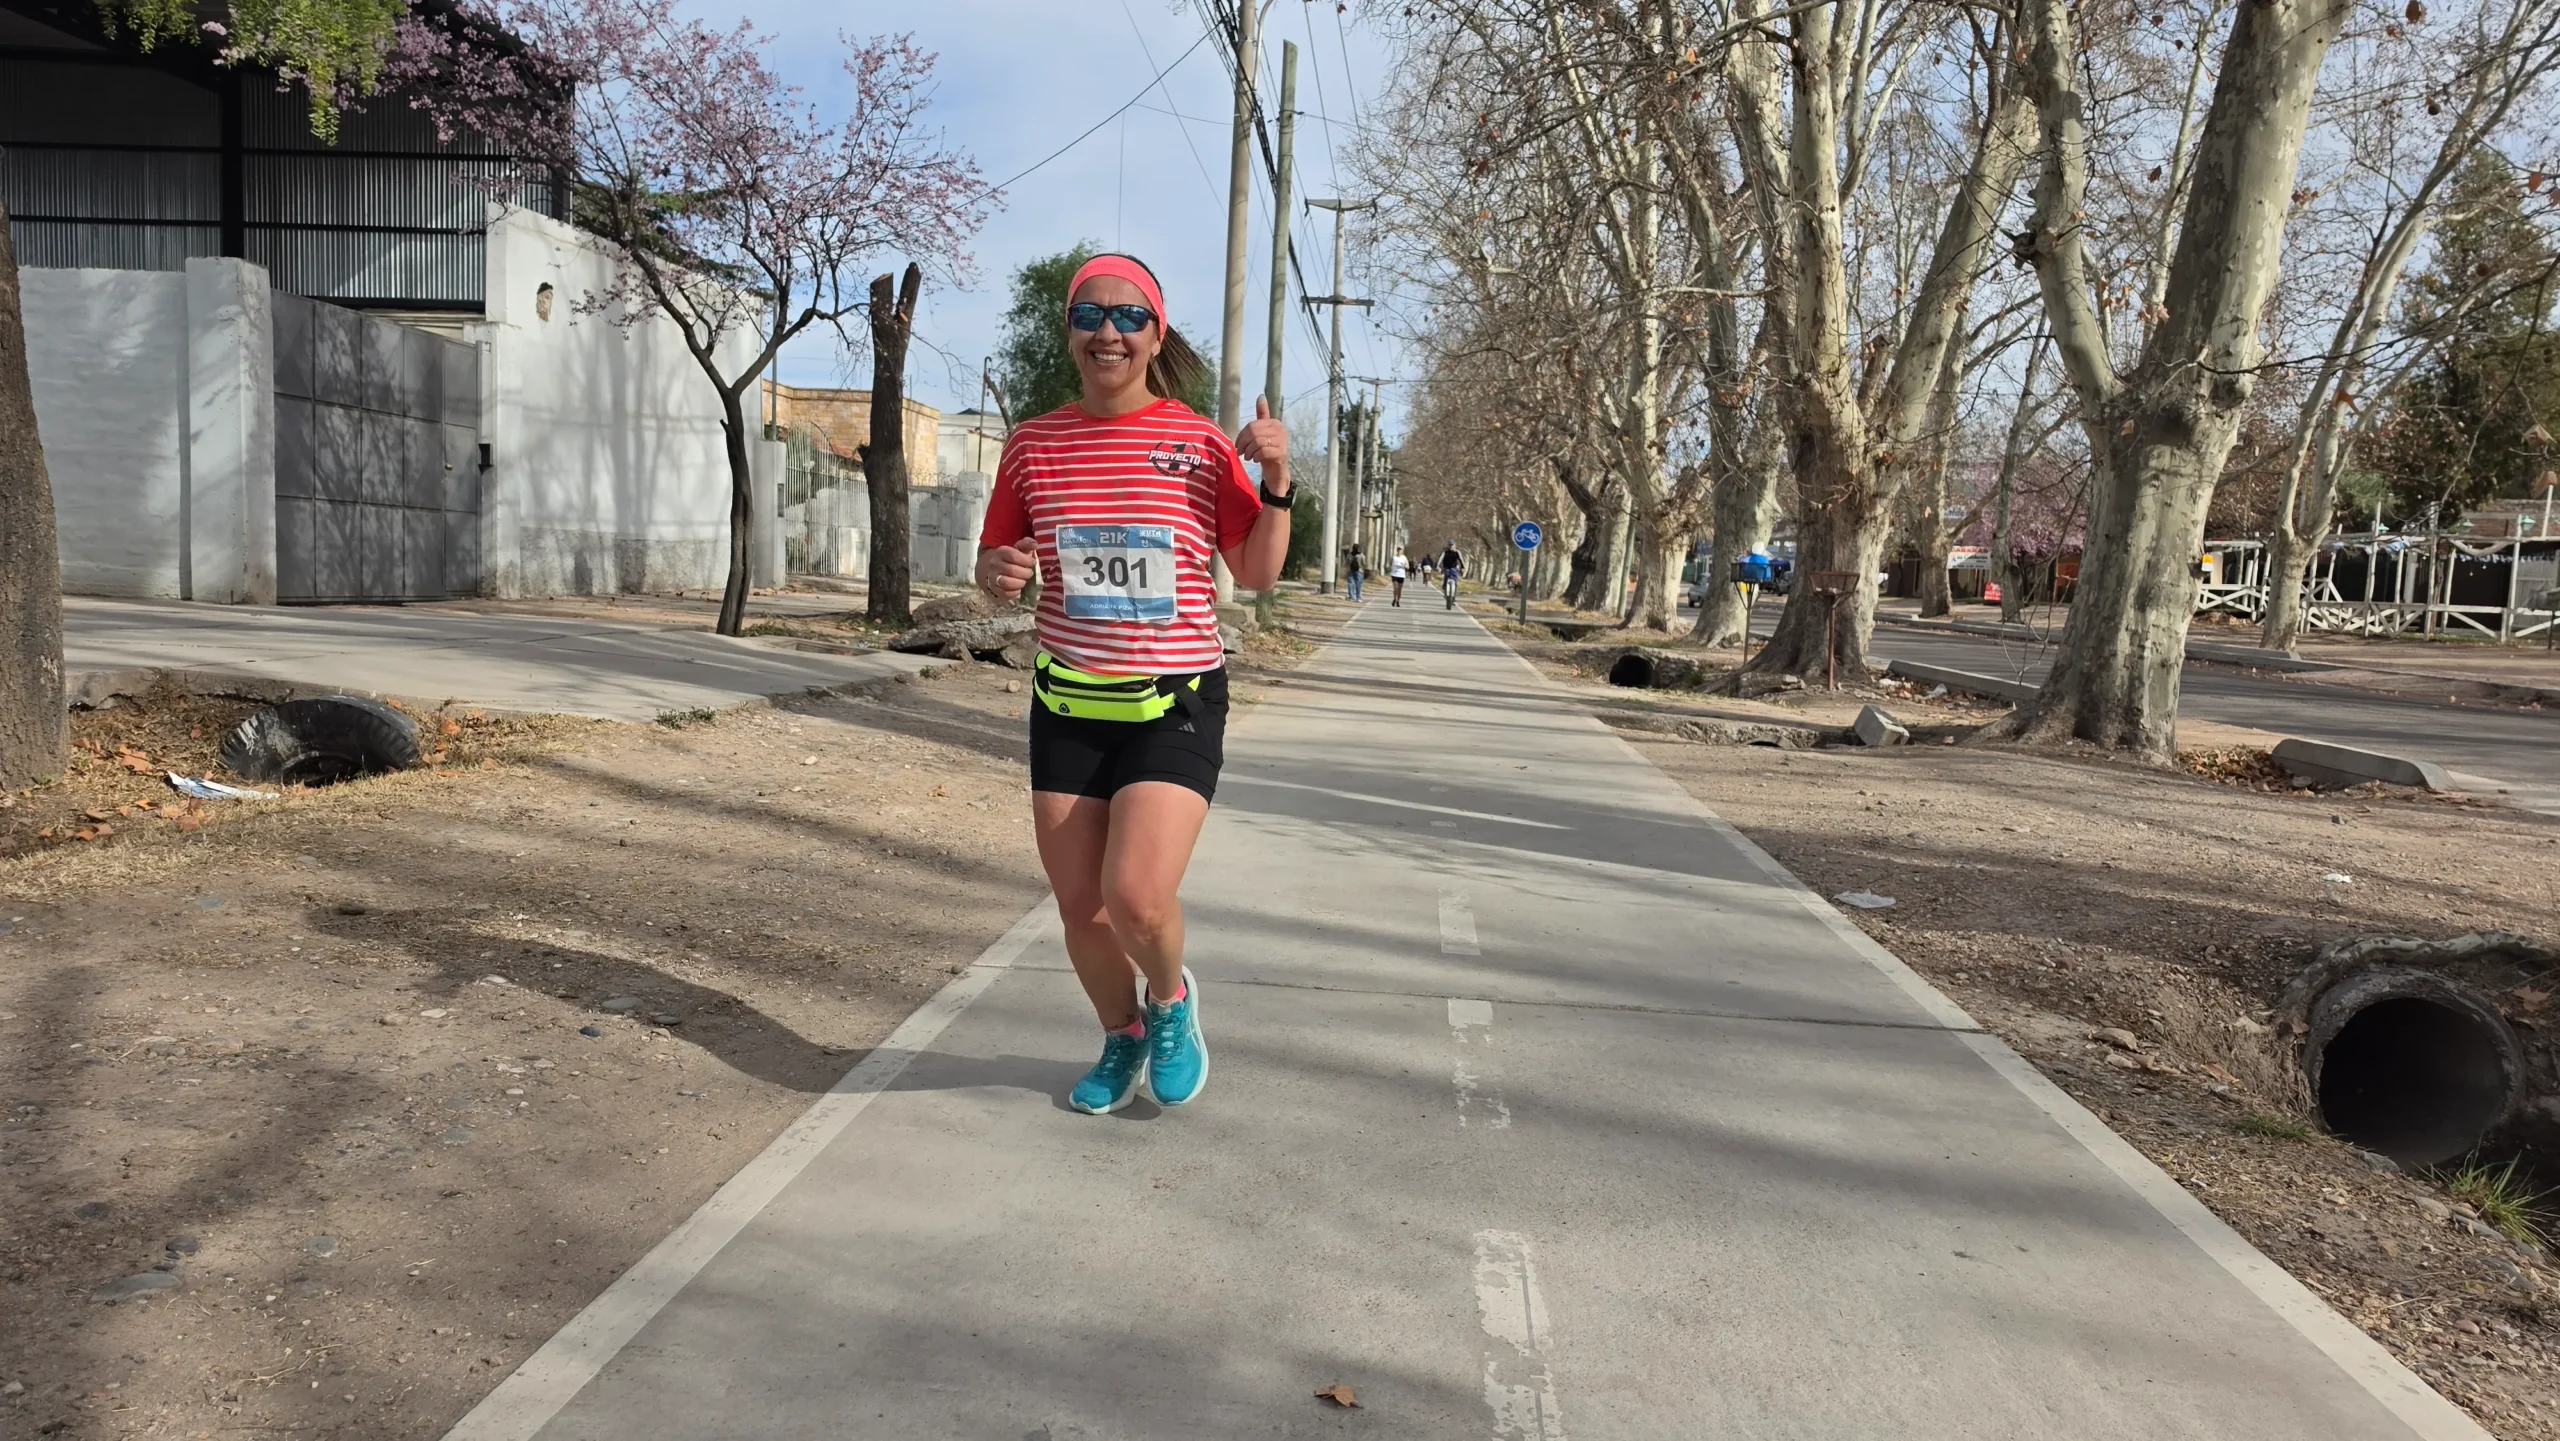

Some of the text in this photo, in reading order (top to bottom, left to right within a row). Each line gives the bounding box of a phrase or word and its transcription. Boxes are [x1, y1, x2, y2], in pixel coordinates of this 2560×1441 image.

[1149, 450, 1201, 467] PROYECTO
[1099, 531, 1128, 544] 21K
[1082, 556, 1148, 589] 301
